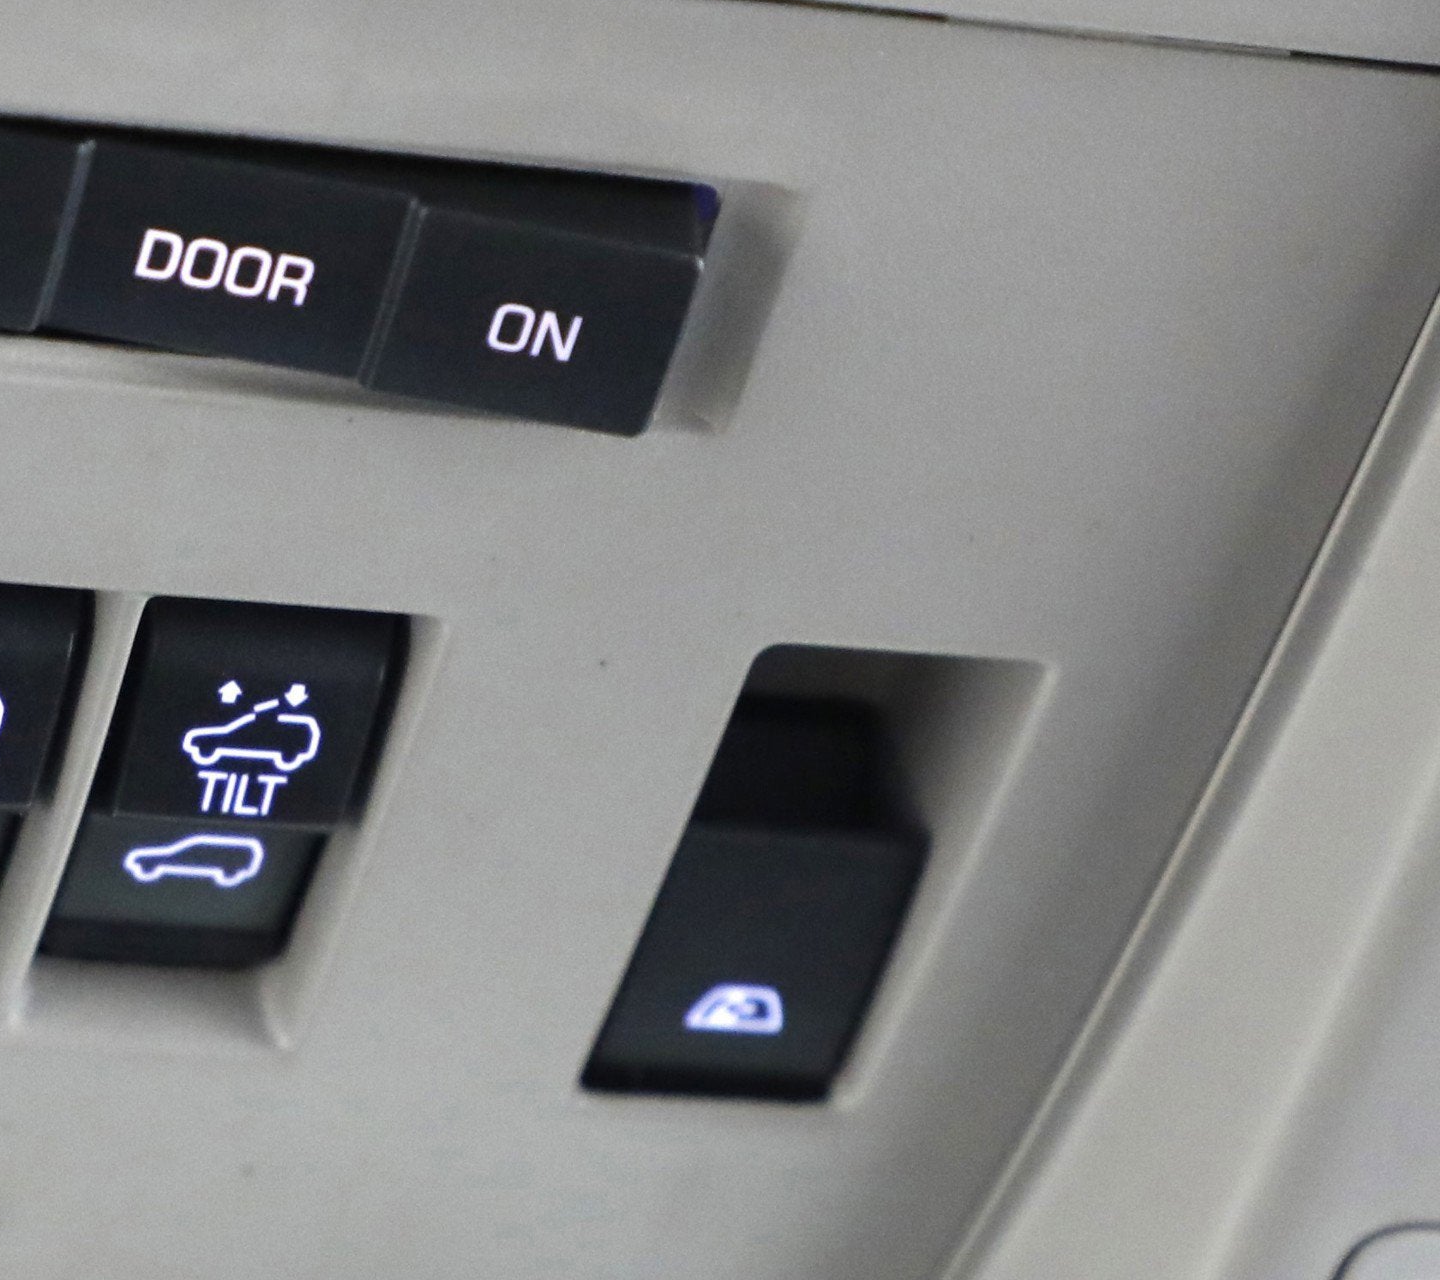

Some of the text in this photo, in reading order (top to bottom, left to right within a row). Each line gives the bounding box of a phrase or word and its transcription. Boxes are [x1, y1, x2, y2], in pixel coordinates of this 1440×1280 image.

[133, 229, 314, 307] DOOR
[486, 303, 582, 362] ON
[197, 770, 288, 816] TILT
